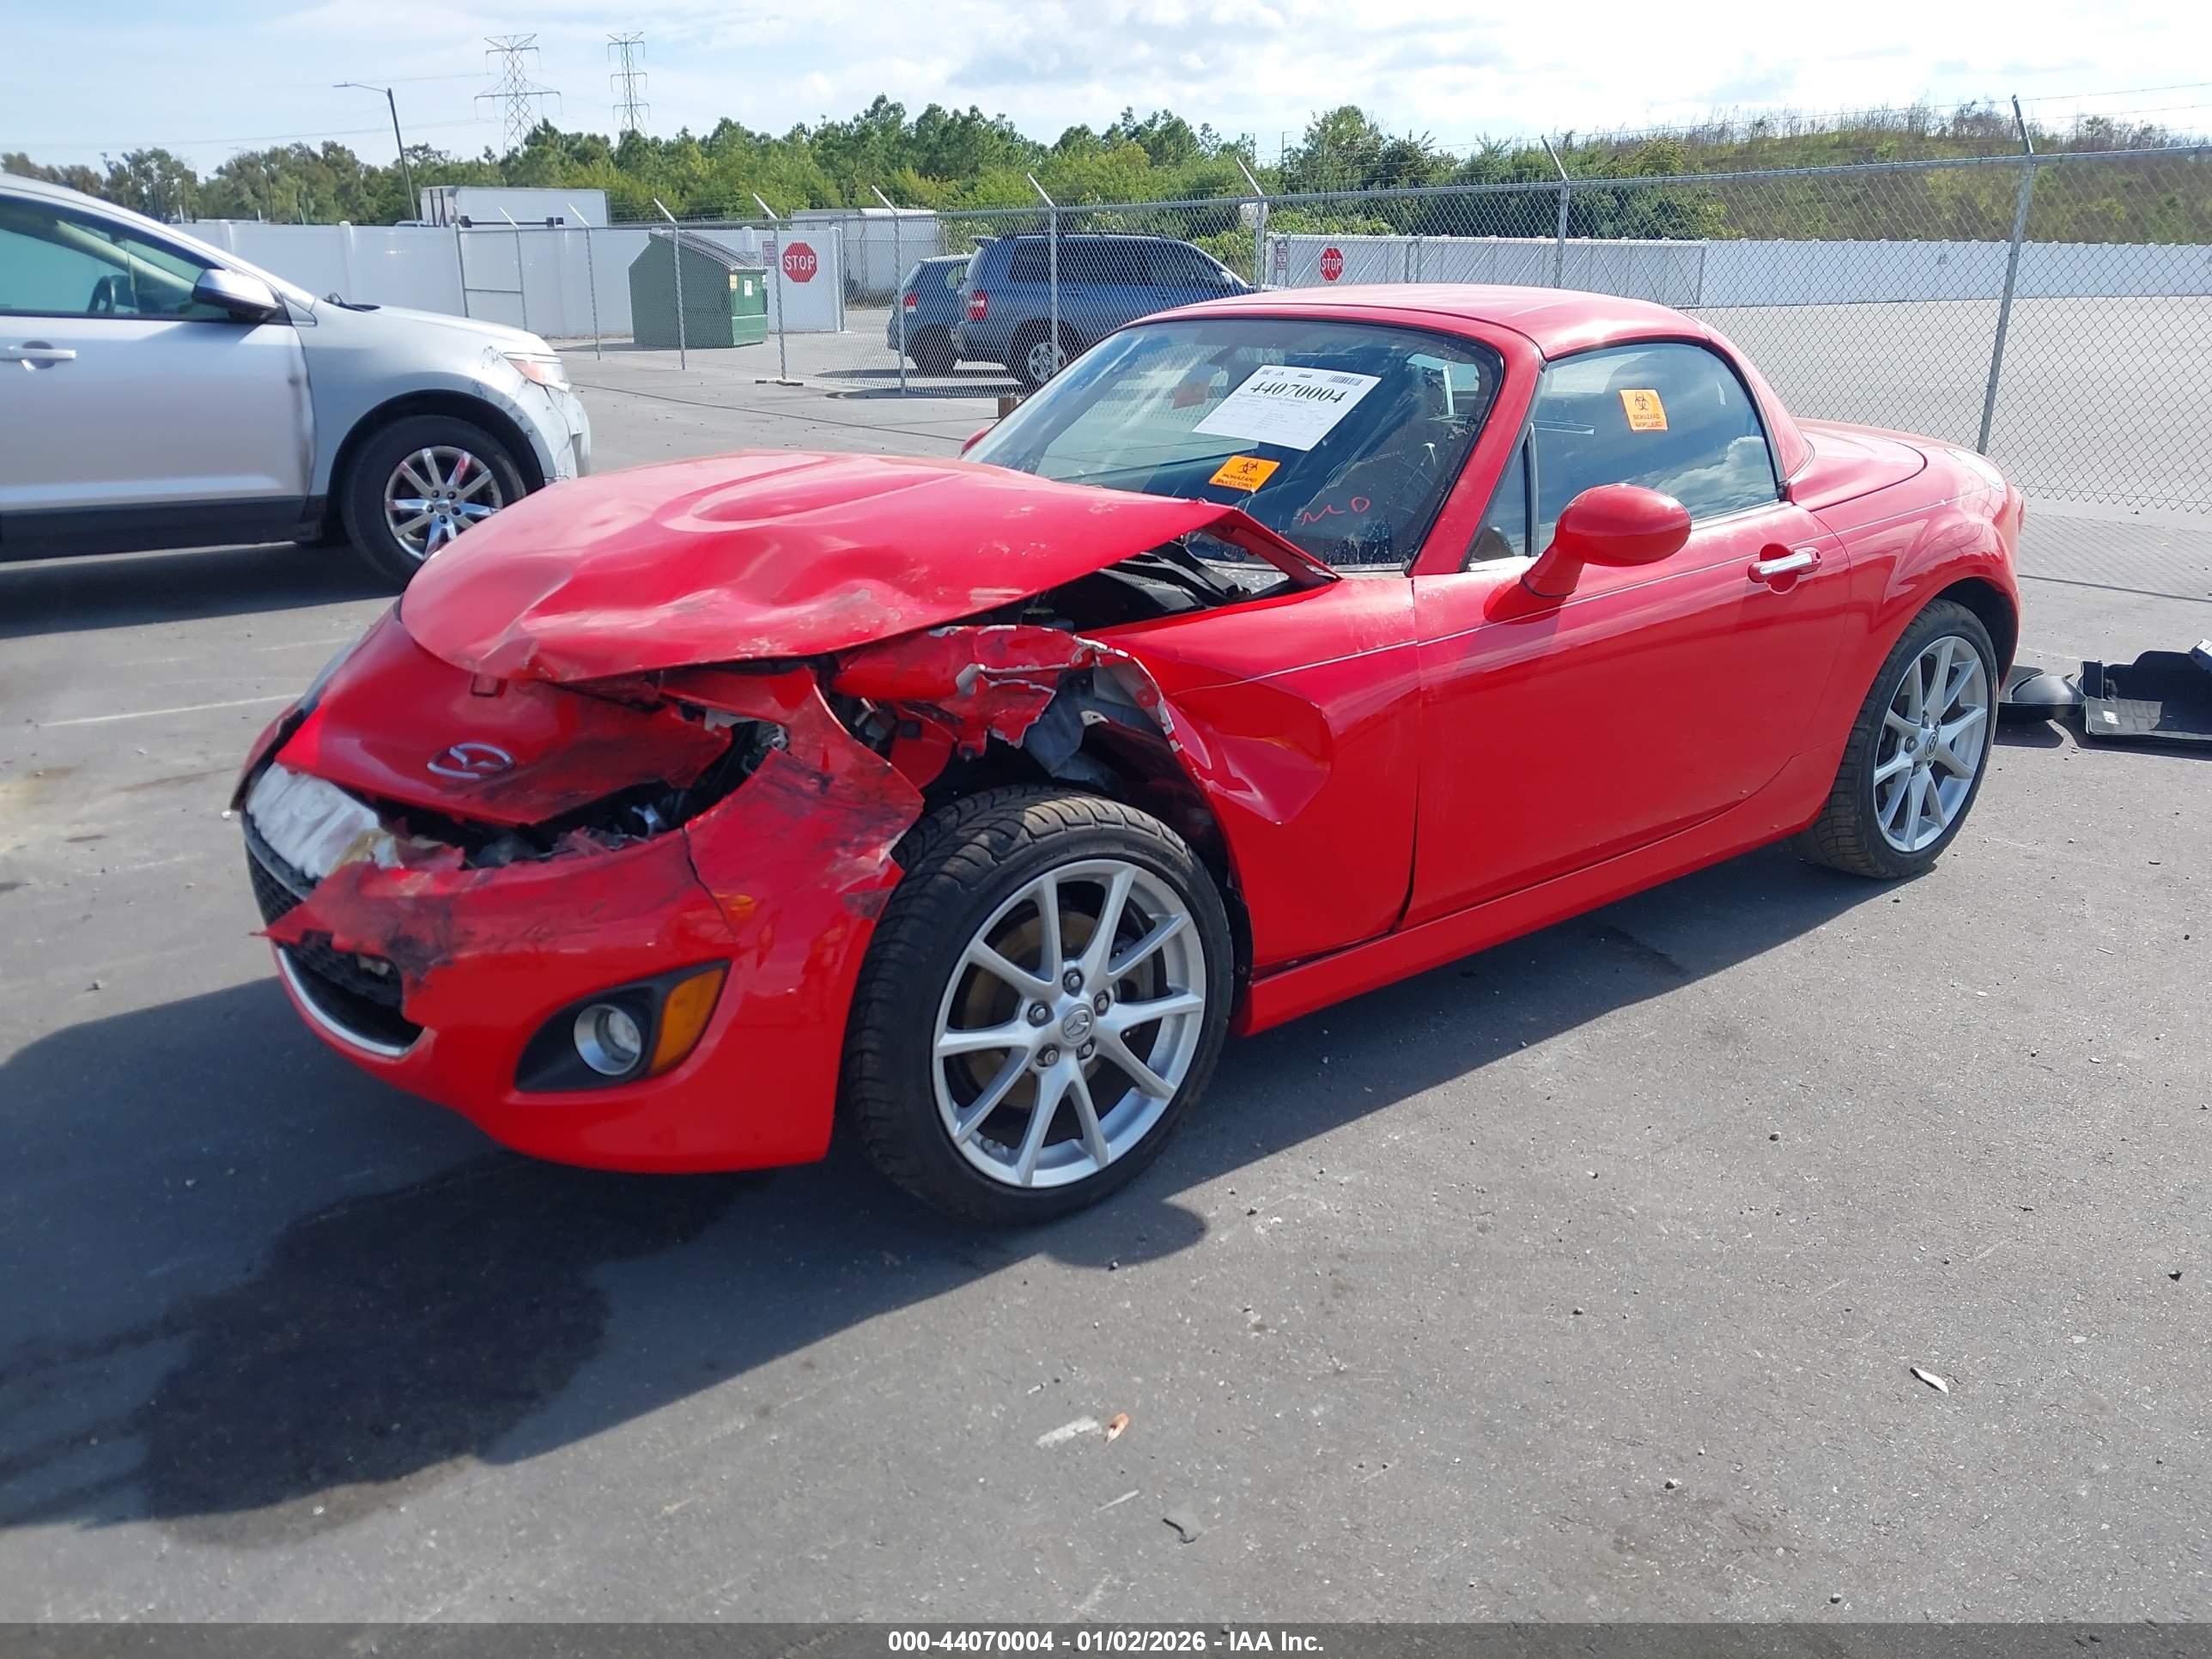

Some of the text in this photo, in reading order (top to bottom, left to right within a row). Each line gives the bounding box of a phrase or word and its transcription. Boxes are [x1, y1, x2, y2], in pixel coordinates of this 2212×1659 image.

[784, 255, 816, 270] STOP
[1321, 258, 1342, 270] STOP
[1249, 380, 1348, 404] 44070004
